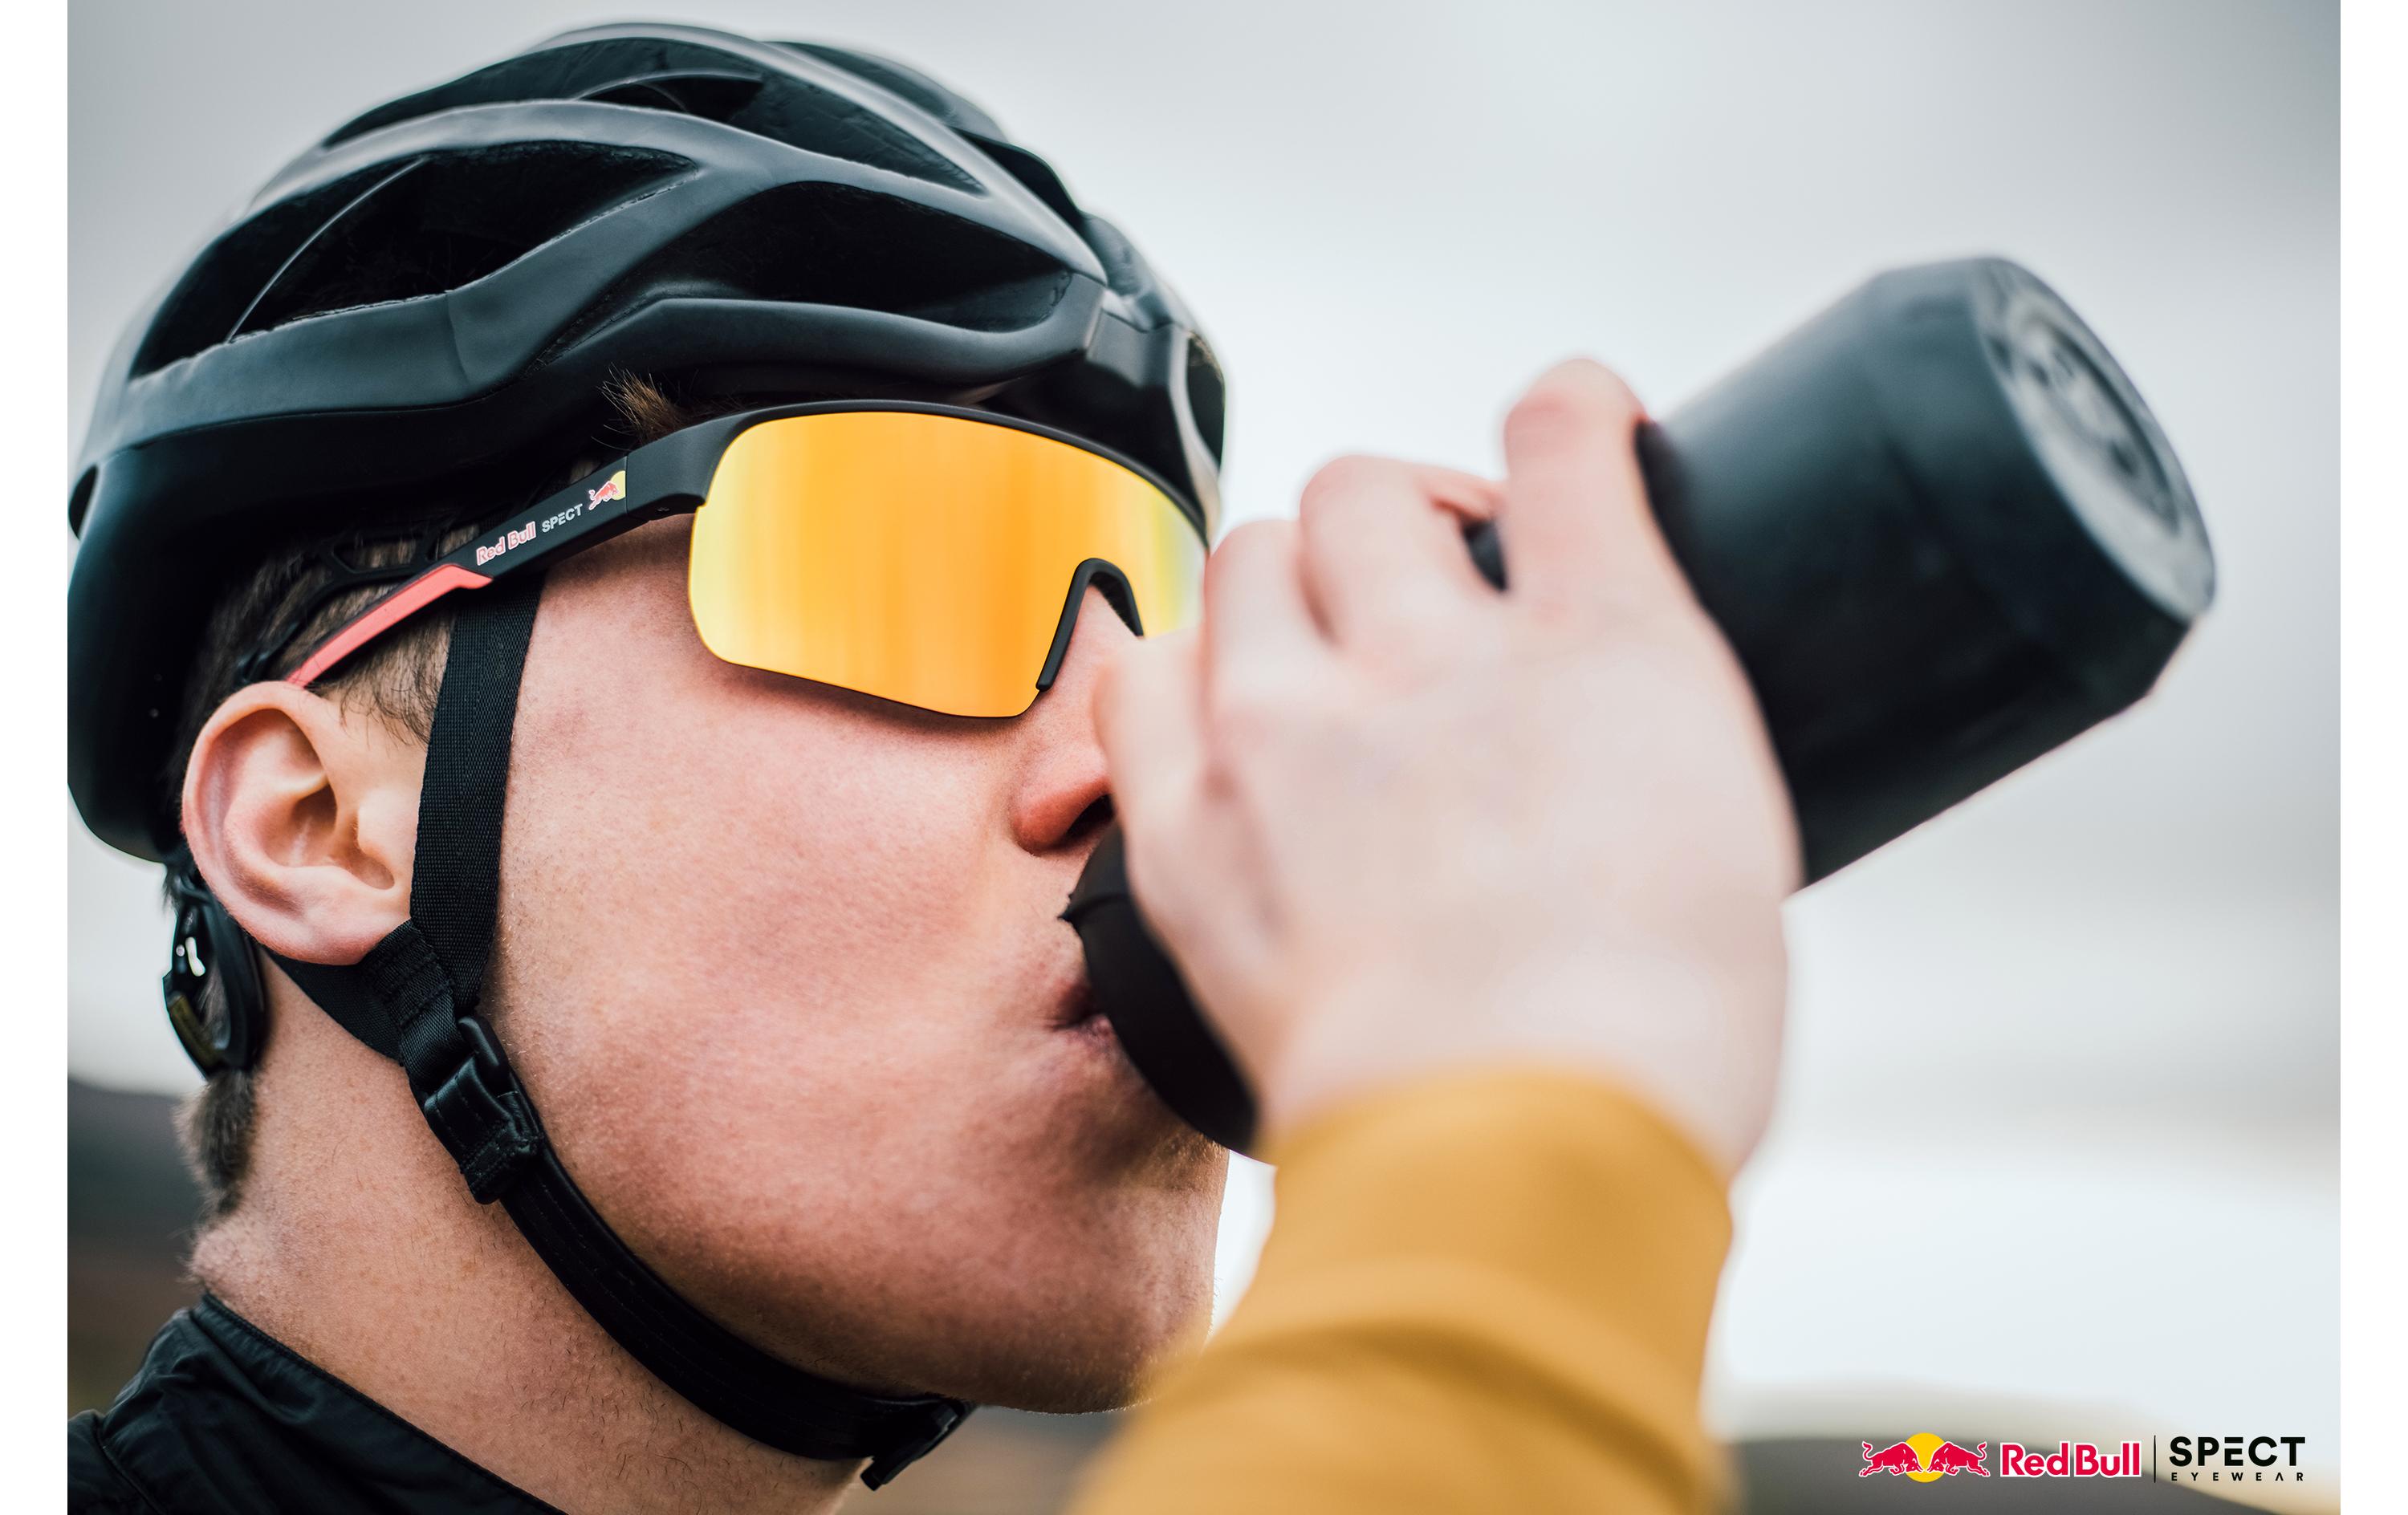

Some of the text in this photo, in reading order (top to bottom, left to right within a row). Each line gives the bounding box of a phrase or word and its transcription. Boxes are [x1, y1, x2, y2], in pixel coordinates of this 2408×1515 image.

[476, 503, 583, 566] Red Bull SPECT
